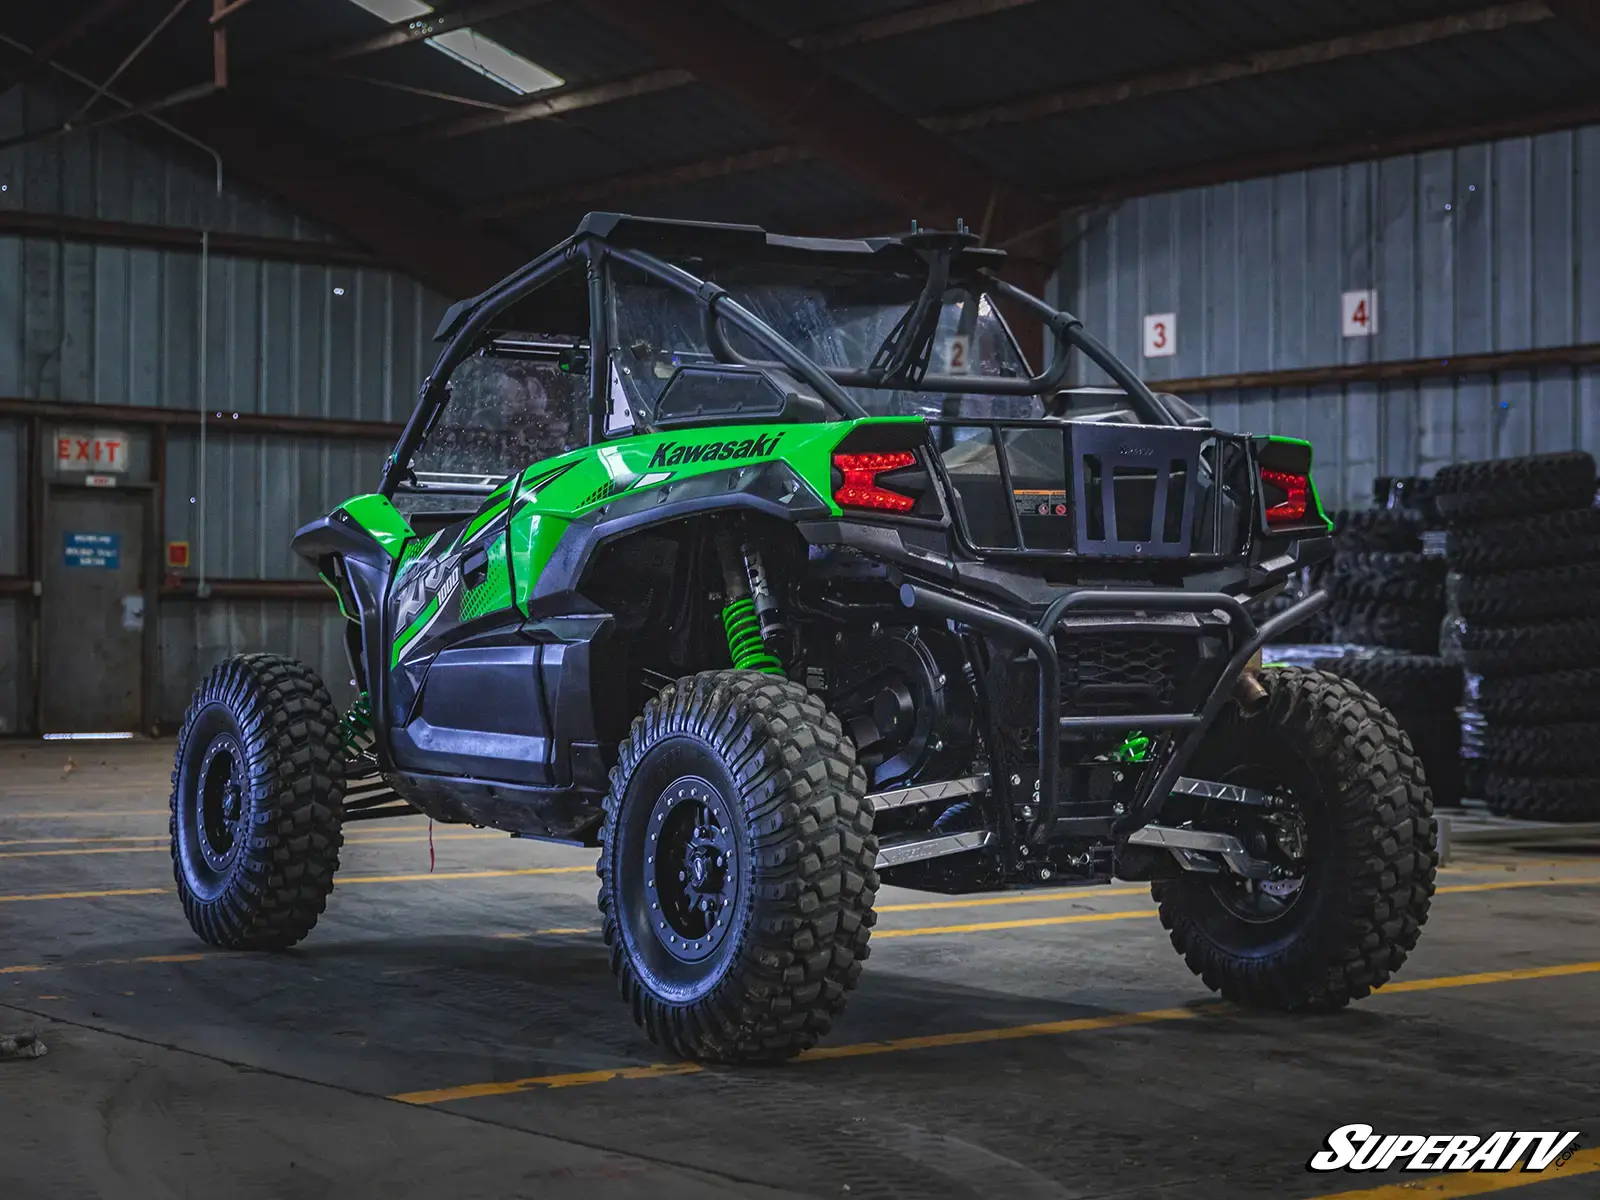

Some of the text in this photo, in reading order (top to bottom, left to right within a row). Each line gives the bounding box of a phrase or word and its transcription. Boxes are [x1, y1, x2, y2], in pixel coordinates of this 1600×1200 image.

[1352, 299, 1369, 327] 4
[1153, 322, 1168, 349] 3
[951, 341, 964, 367] 2
[57, 438, 121, 462] EXIT
[648, 431, 786, 468] Kawasaki
[437, 566, 459, 606] 1000
